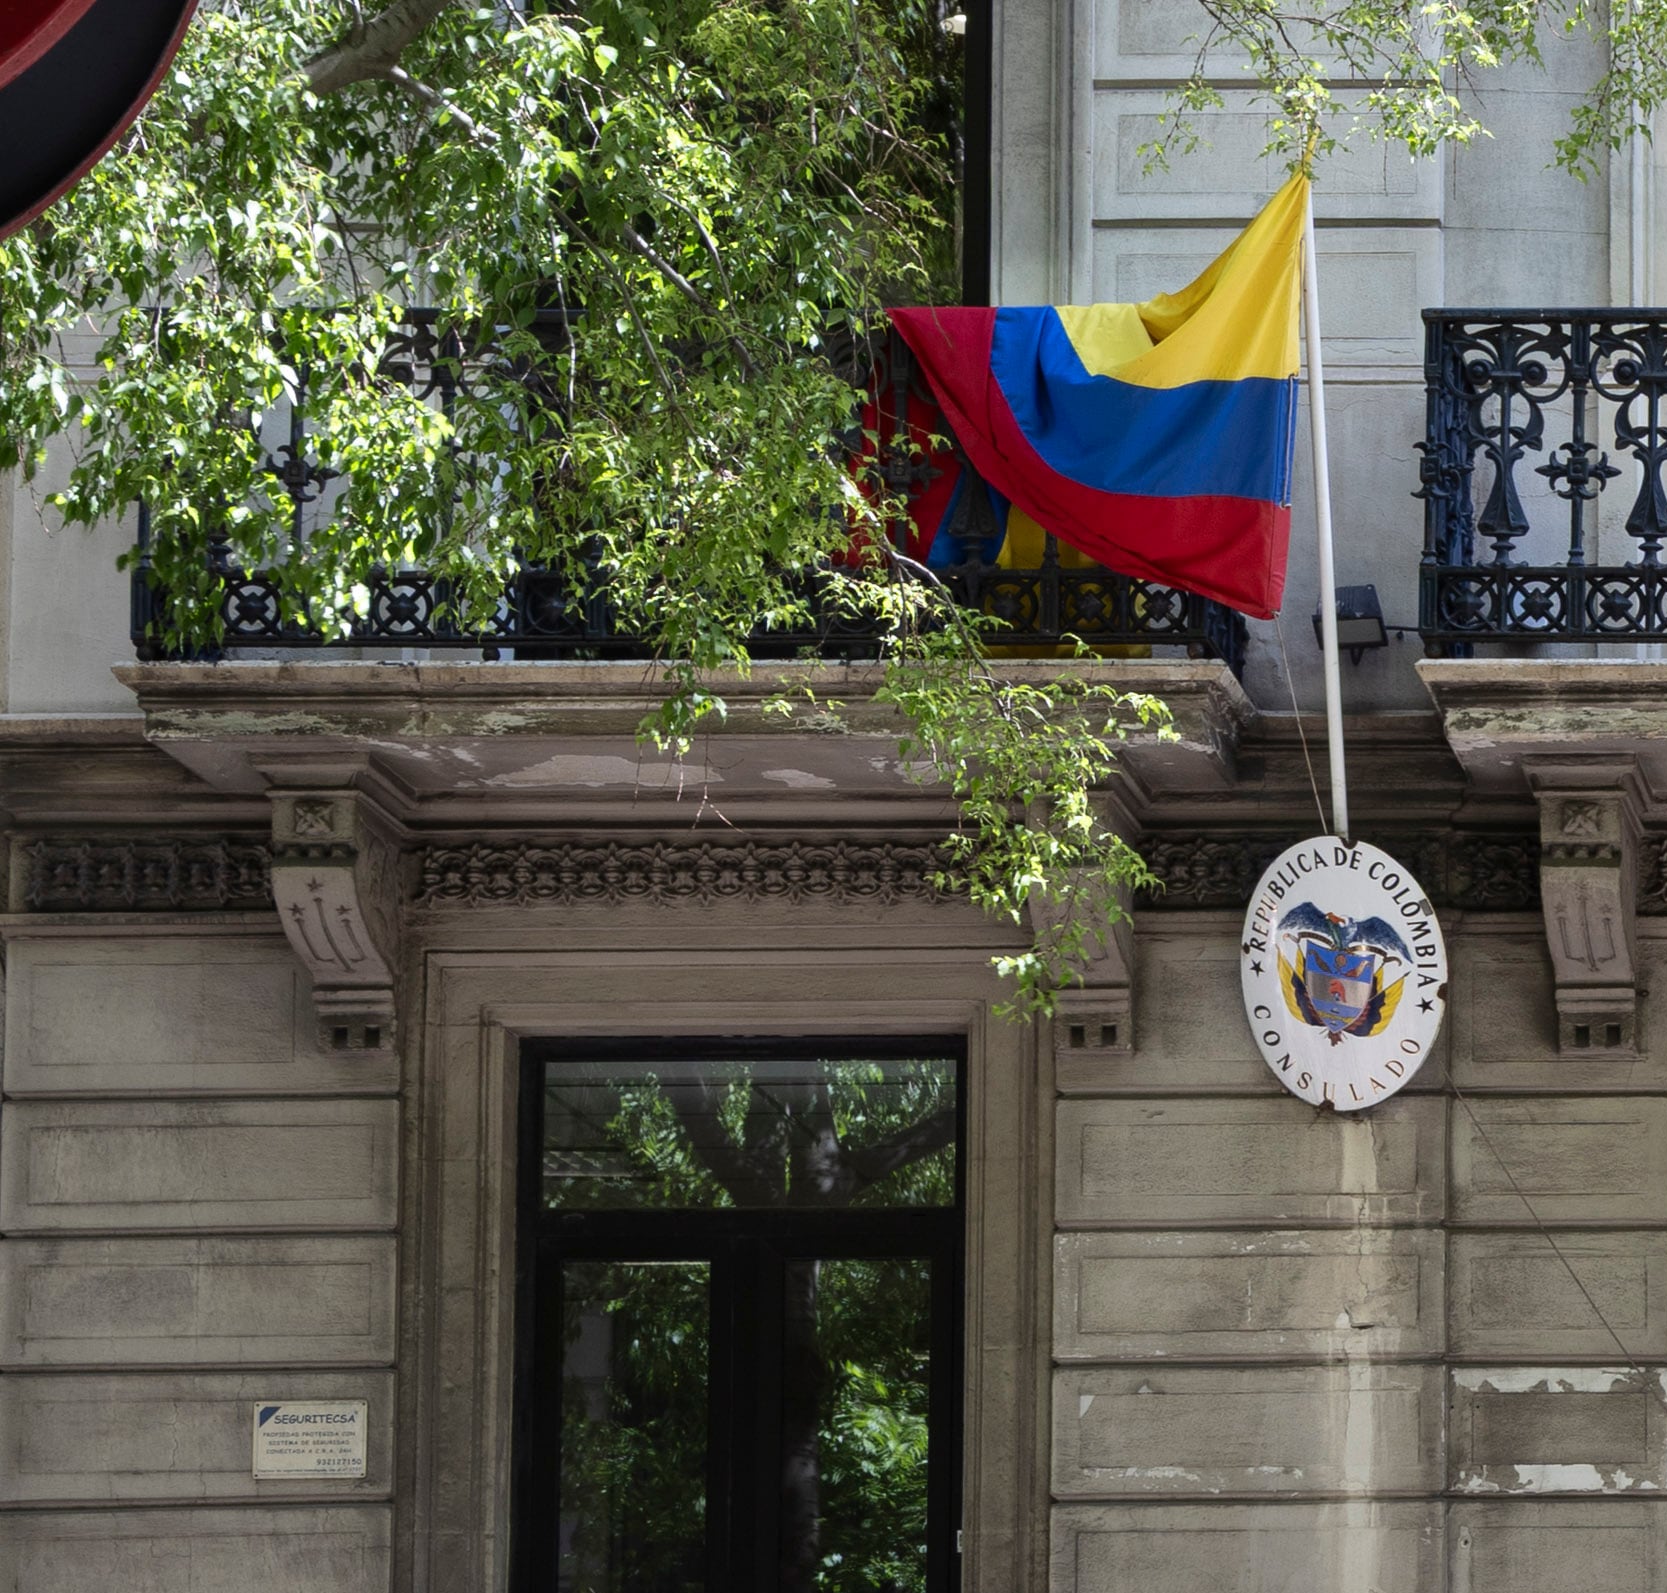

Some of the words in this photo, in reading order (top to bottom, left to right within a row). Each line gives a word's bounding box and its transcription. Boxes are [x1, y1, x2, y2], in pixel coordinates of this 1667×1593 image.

[1250, 847, 1329, 954] REPUBLICA
[1334, 847, 1363, 870] DE
[1368, 861, 1439, 989] COLOMBIA
[1253, 1004, 1421, 1101] CONSULADO
[274, 1413, 356, 1425] SEGURITECSA
